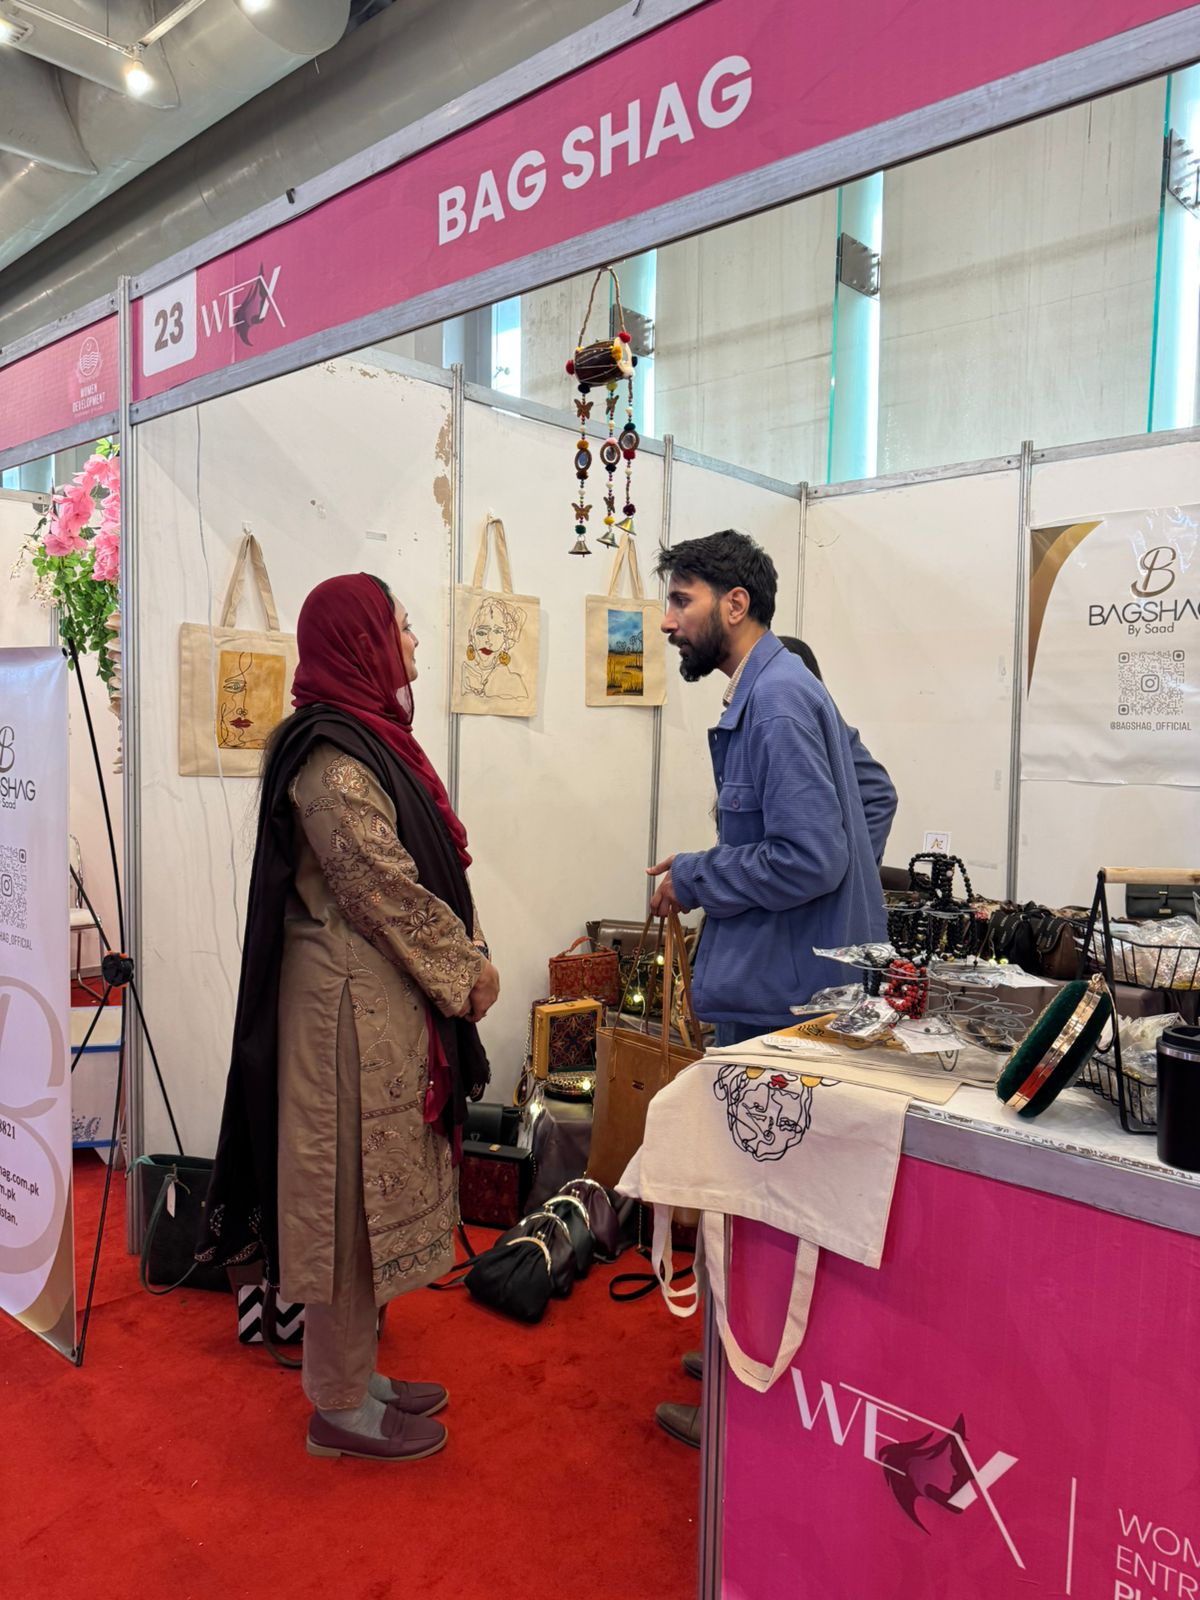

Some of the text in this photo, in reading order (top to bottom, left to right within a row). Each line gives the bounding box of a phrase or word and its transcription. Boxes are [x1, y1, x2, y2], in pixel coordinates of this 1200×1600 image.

[438, 54, 753, 246] BAG SHAG
[154, 301, 184, 352] 23
[201, 265, 286, 339] WEX
[1089, 598, 1200, 627] BAGSHA
[1128, 622, 1175, 637] By Saad
[1110, 720, 1192, 732] @BAGSHAG_OFFICIAL
[791, 1366, 1026, 1570] WEX
